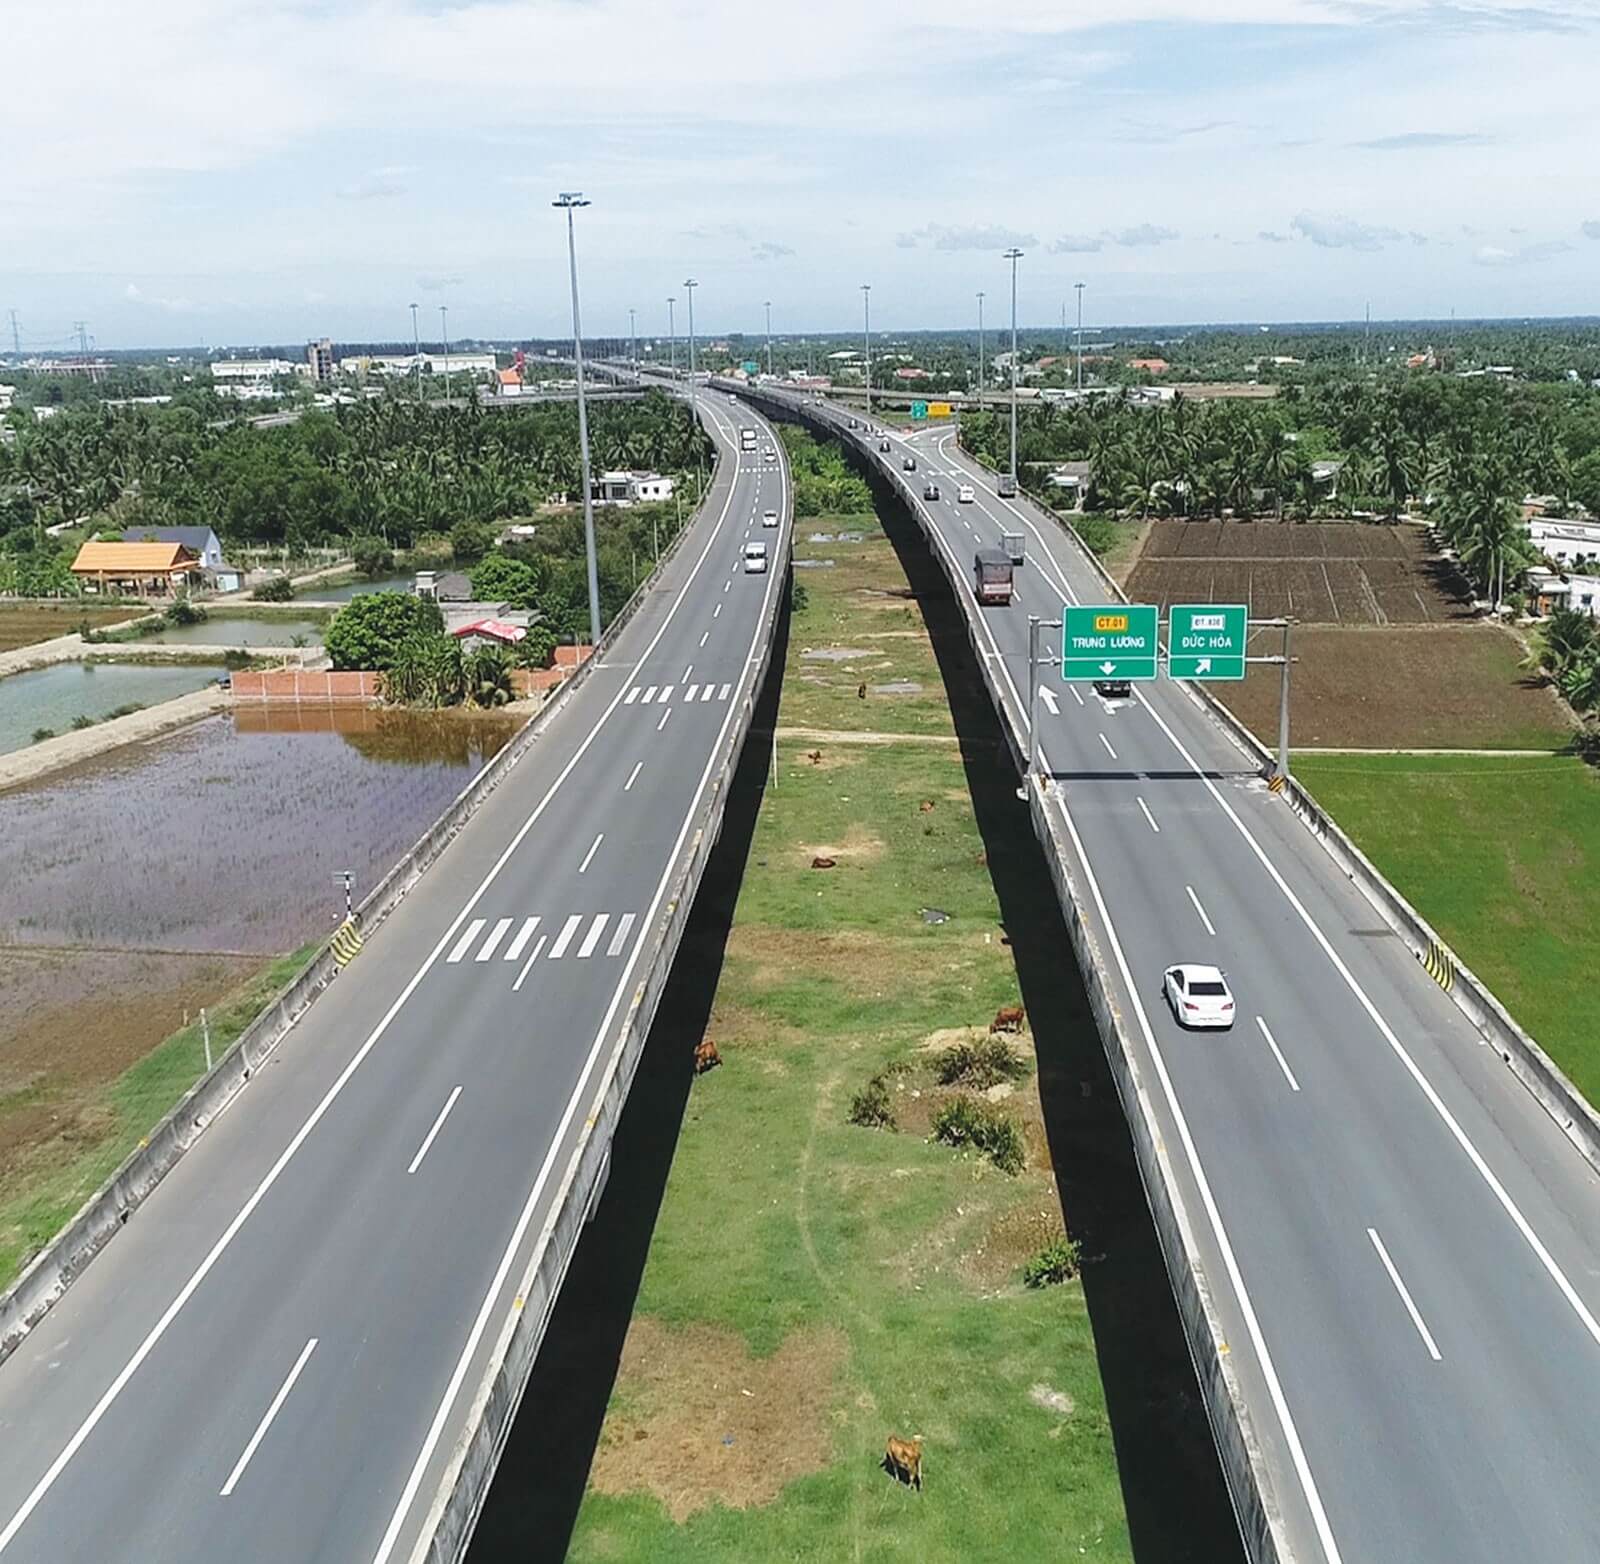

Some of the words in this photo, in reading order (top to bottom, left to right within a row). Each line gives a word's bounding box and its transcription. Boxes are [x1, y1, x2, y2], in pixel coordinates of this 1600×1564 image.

[1072, 637, 1106, 649] TRUNG
[1182, 633, 1206, 648] ĐỨC
[1209, 633, 1233, 648] HÒA
